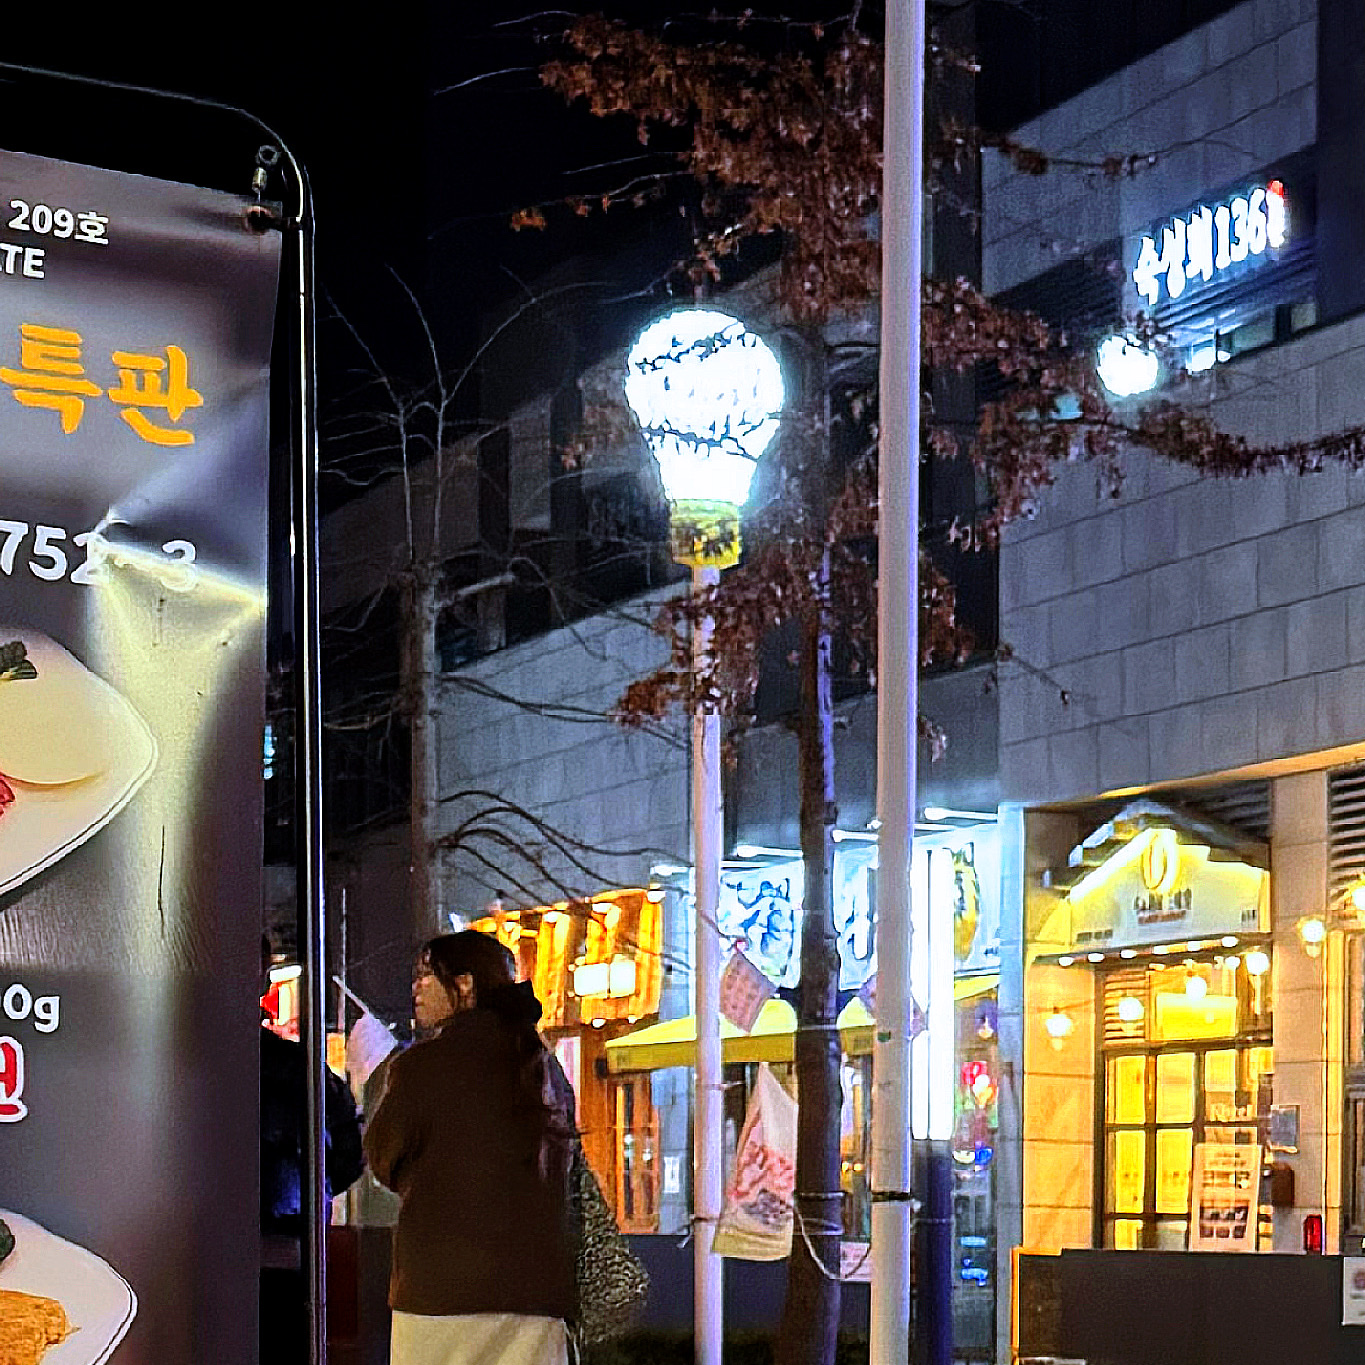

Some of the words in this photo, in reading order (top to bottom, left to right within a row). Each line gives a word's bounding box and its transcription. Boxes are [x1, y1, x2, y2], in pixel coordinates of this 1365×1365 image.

[8, 200, 109, 245] 209호
[0, 242, 45, 279] TE
[0, 323, 204, 446] 특판
